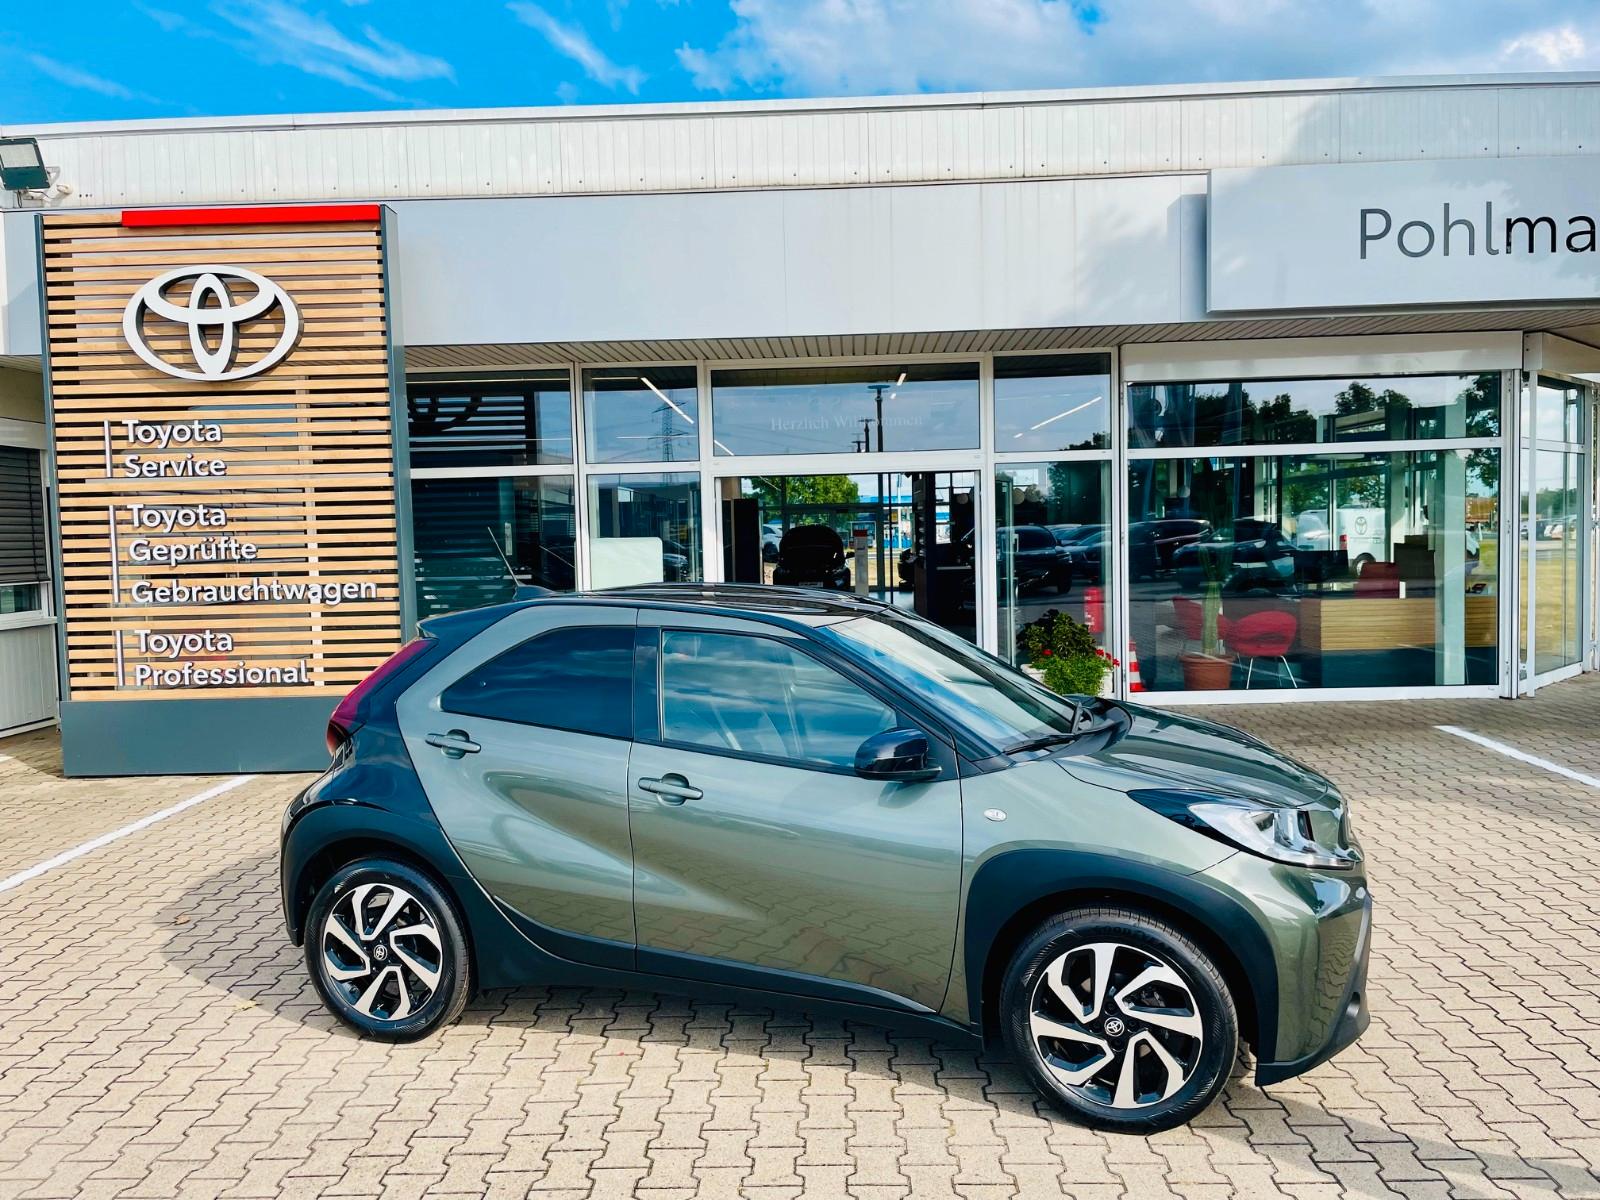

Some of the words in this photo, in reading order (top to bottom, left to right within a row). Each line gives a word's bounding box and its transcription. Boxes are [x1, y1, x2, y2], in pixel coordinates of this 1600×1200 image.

[1359, 201, 1596, 260] Pohlma
[121, 419, 222, 449] Toyota
[770, 415, 830, 431] Herzlich
[833, 413, 923, 429] Willommen
[124, 453, 227, 478] Service
[126, 503, 227, 533] Toyota
[128, 536, 258, 566] Geprüfte
[131, 577, 377, 605] Gebrauchtwagen
[134, 629, 233, 658] Toyota
[134, 659, 310, 687] Professional
